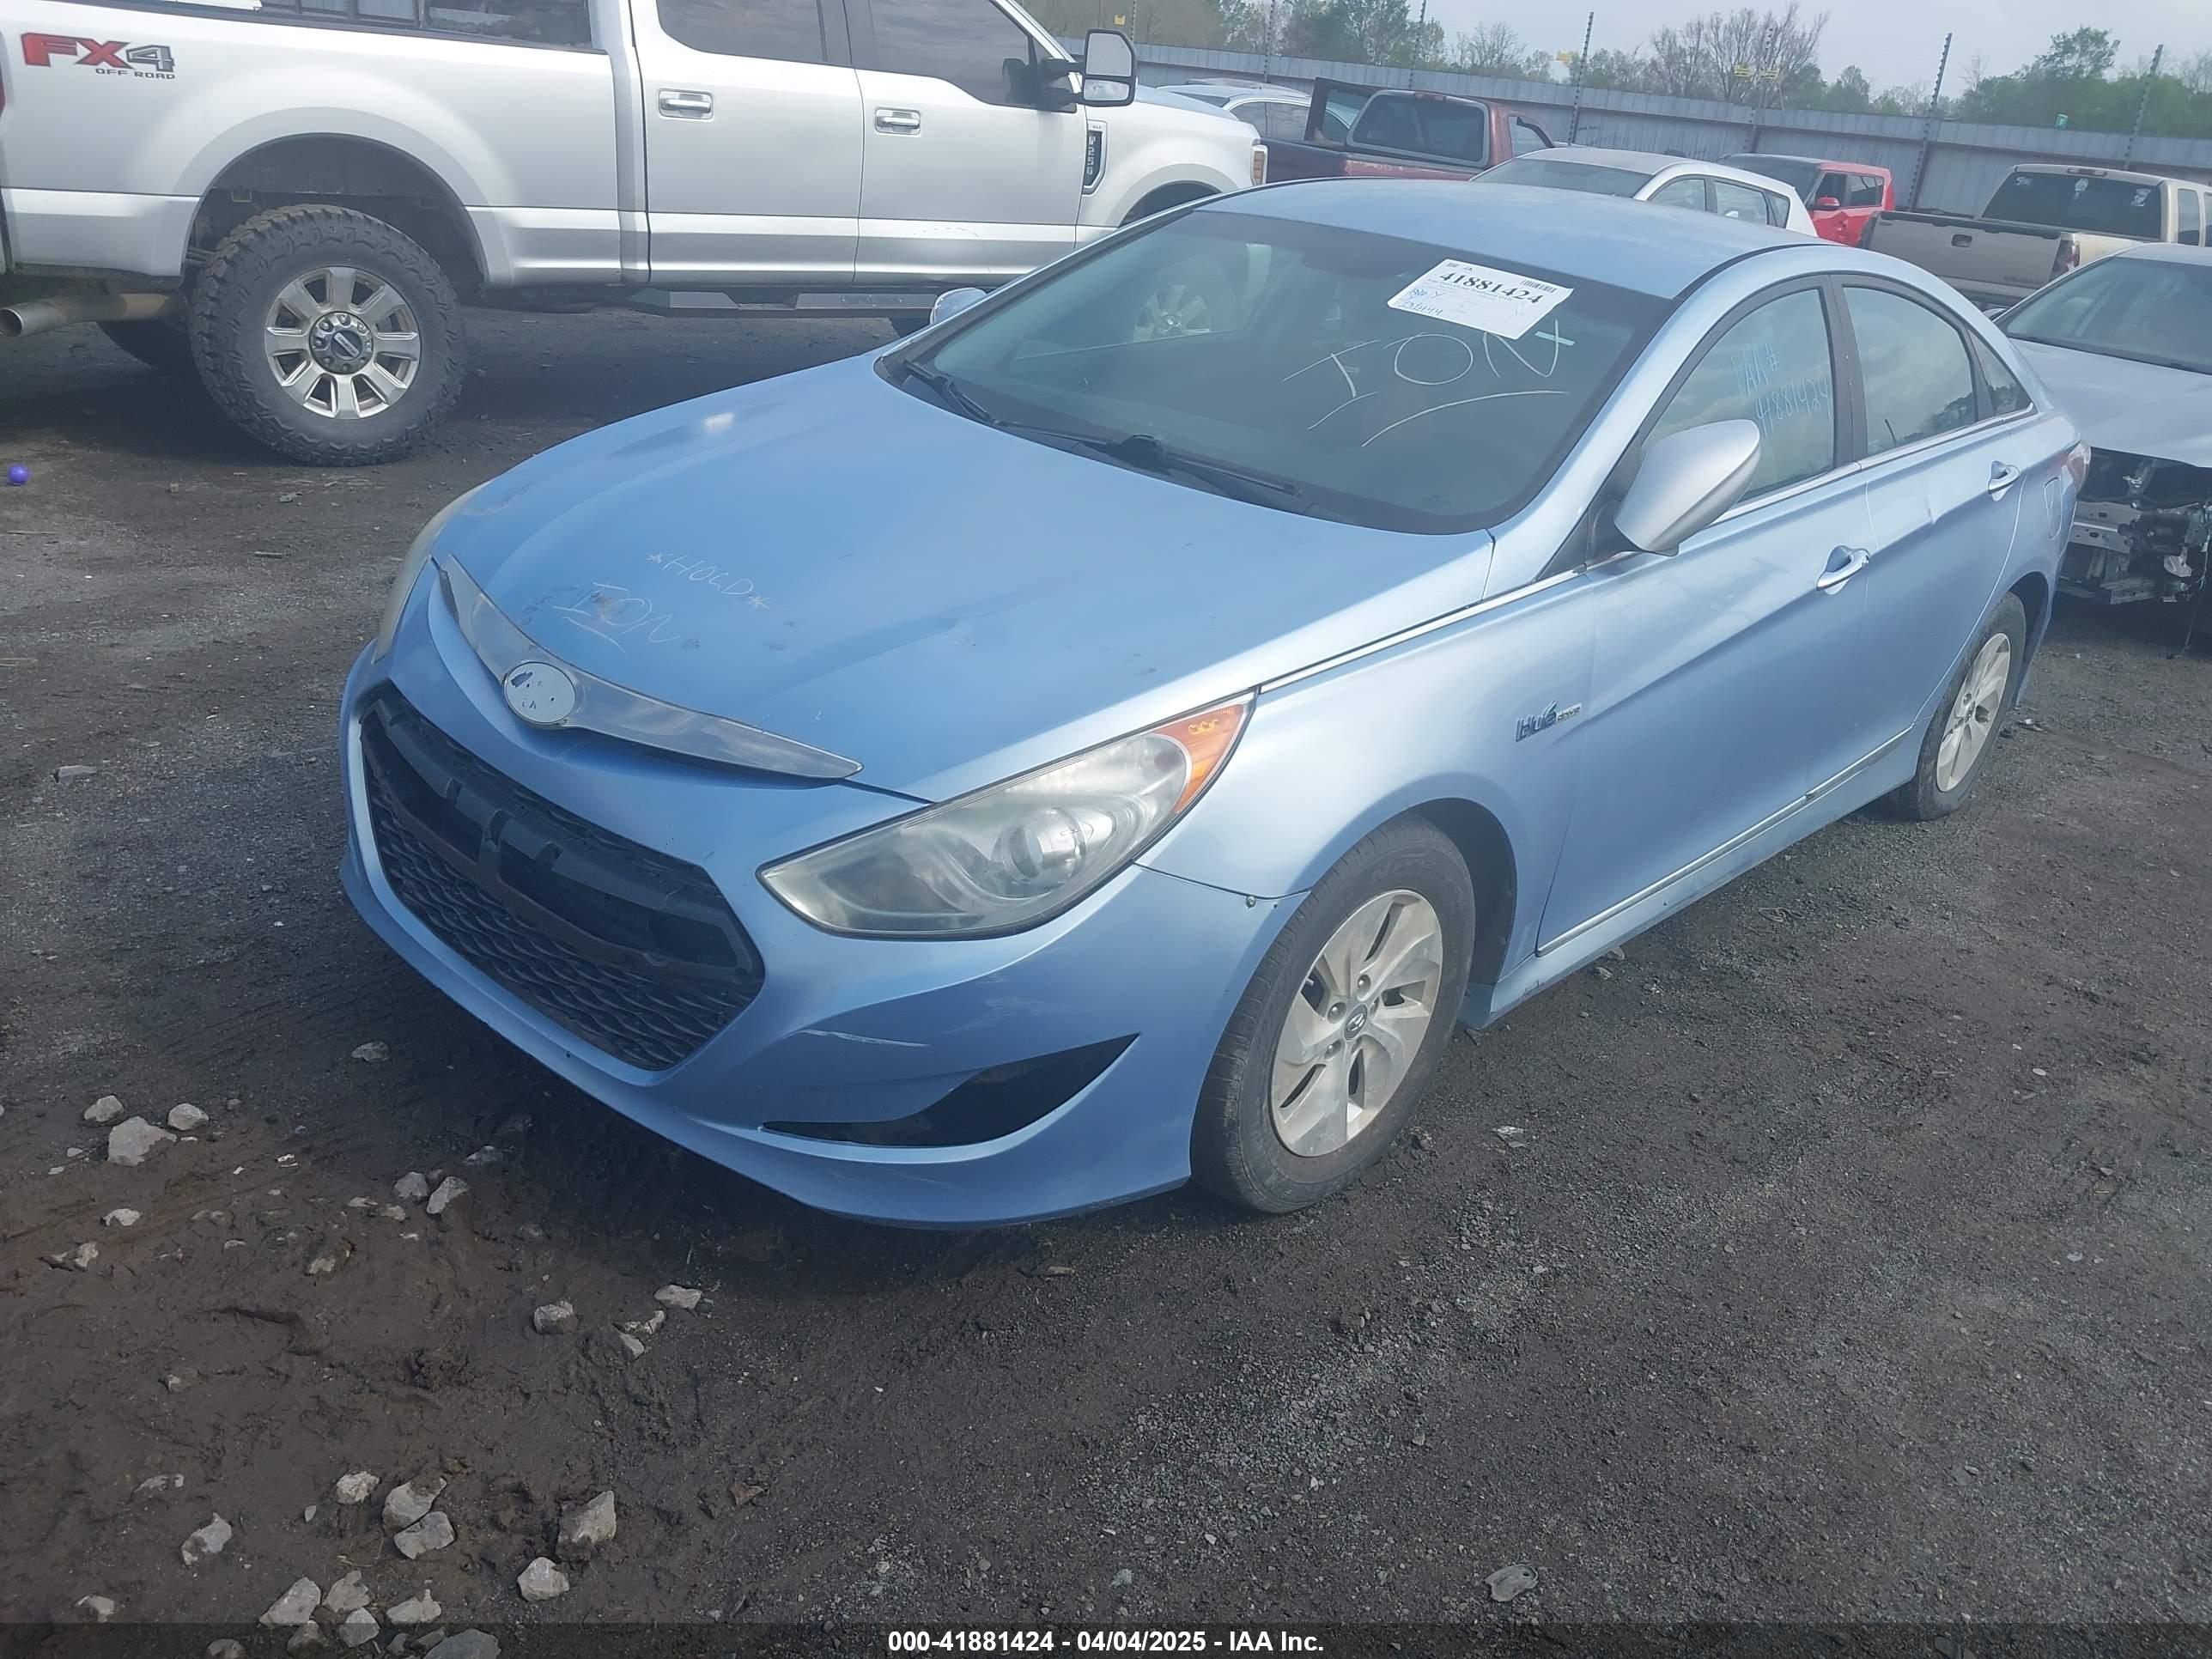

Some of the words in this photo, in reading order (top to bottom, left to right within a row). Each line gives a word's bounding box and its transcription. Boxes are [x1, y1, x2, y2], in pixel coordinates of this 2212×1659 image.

[21, 32, 174, 72] FX4
[134, 71, 175, 80] ROAD
[1439, 272, 1544, 304] 41881424
